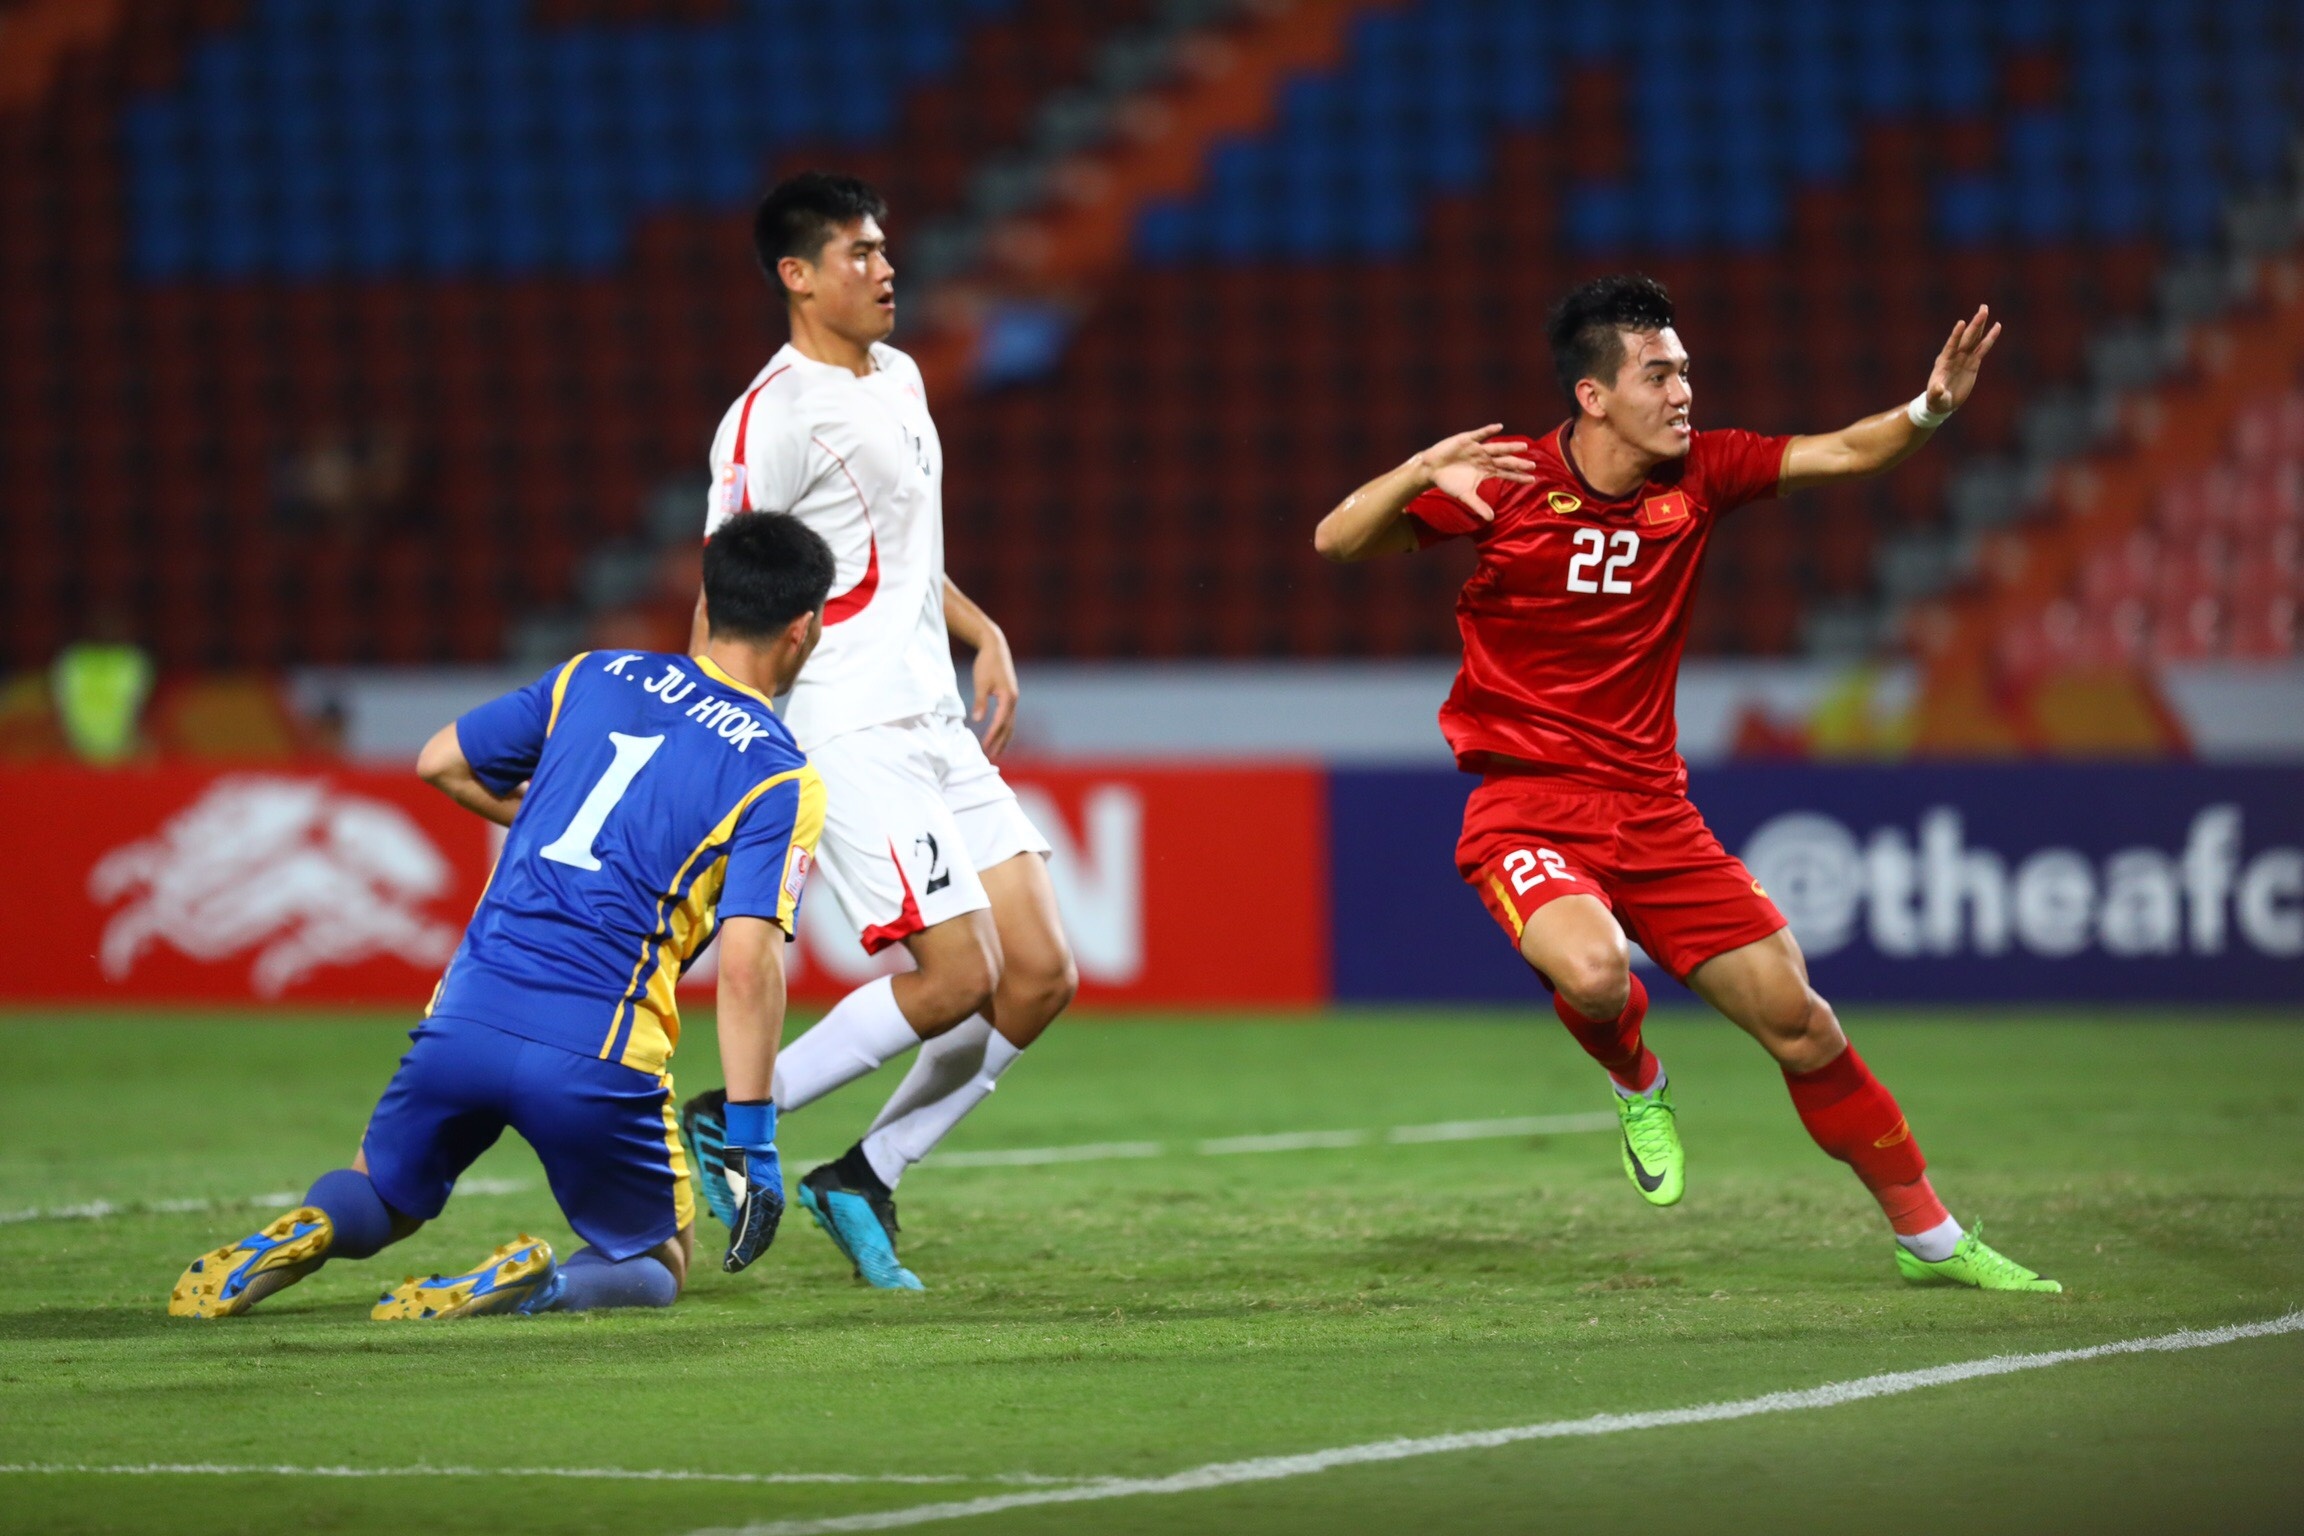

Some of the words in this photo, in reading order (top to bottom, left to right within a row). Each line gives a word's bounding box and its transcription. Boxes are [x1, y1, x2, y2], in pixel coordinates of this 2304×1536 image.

[1566, 527, 1640, 594] 22
[643, 664, 697, 704] JU
[685, 695, 770, 753] HYOK
[539, 731, 666, 871] 1
[914, 832, 951, 895] 2
[1503, 848, 1576, 896] 22
